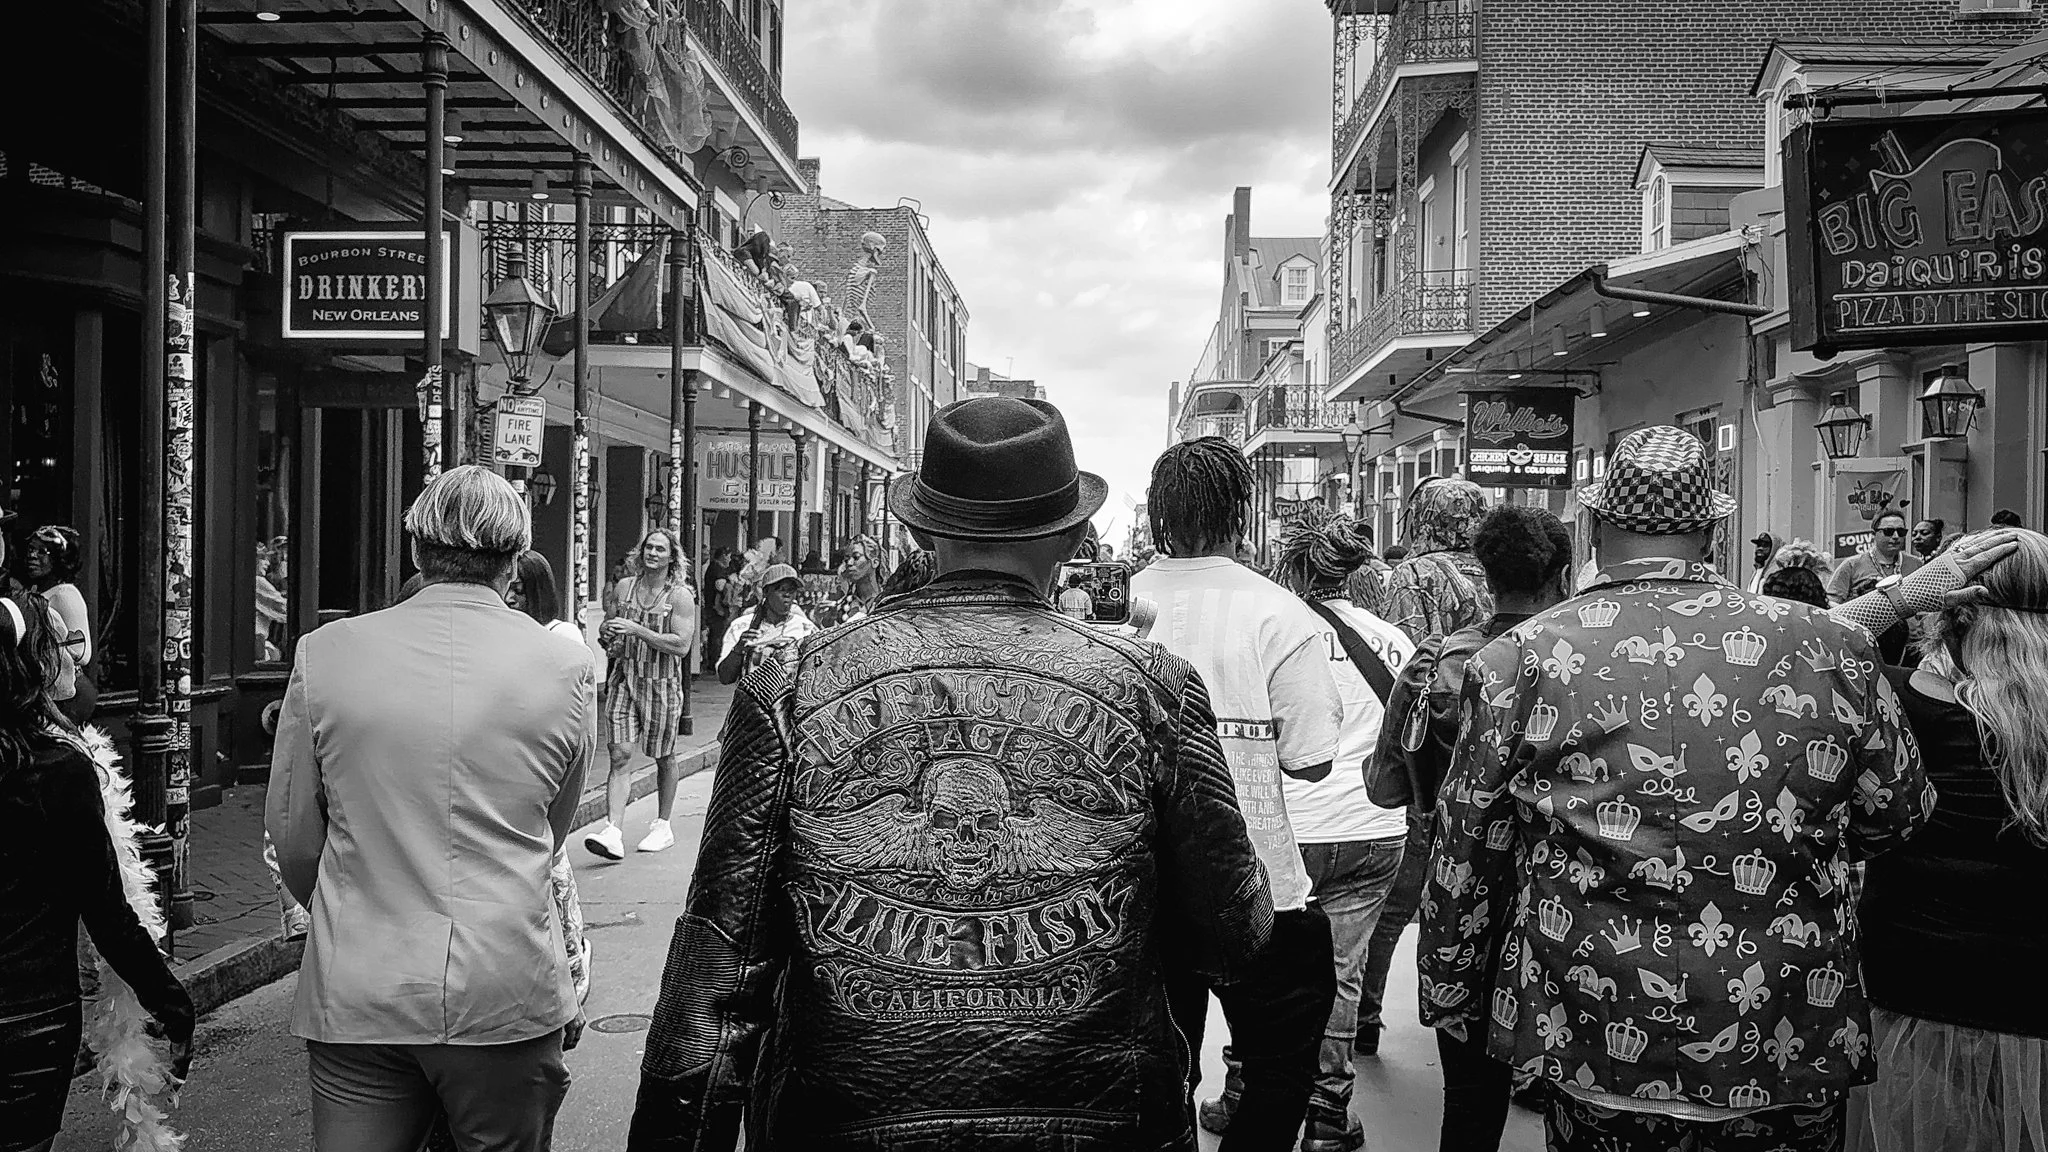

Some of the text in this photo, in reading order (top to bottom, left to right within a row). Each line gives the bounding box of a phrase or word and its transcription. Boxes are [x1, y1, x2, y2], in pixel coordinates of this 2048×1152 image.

[1818, 170, 2047, 256] BIG EAS
[377, 247, 425, 264] STREE
[312, 309, 419, 321] NEW ORLEANS
[1838, 289, 2047, 328] PIZZA BY THE SLIC
[500, 398, 515, 412] NO
[1472, 401, 1568, 433] Willie's
[508, 419, 532, 431] FIRE
[505, 433, 532, 445] LANE
[1470, 452, 1567, 464] CHICKEN SHACK
[814, 674, 1132, 756] AFFLICTION
[937, 722, 998, 751] AC
[828, 889, 1103, 966] LIVE FAST
[867, 986, 1066, 1012] CALIFORNIA
